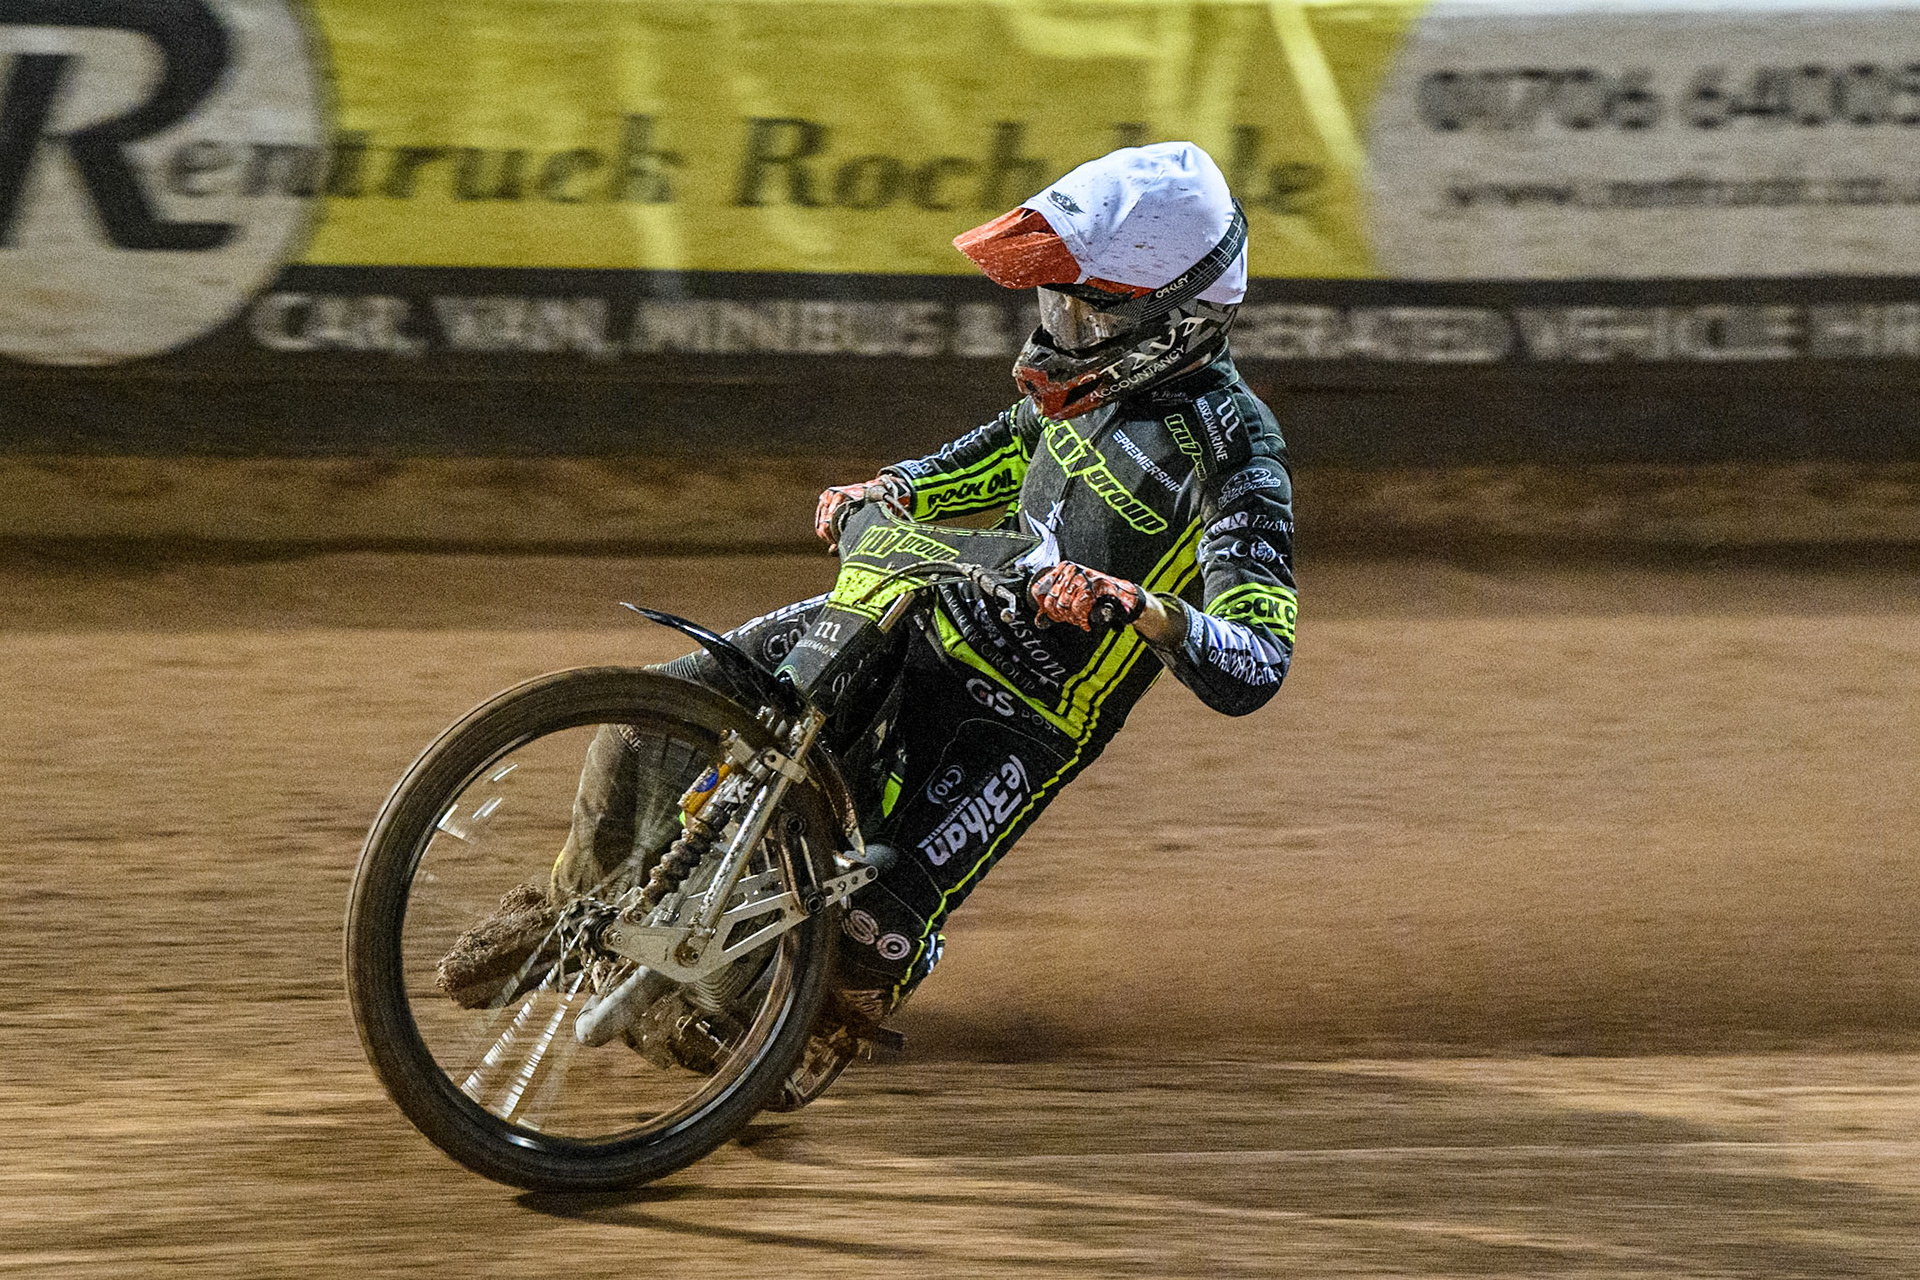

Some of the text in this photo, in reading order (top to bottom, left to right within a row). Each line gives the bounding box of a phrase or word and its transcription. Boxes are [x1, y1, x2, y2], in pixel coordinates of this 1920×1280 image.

[733, 117, 1326, 214] Rochle
[1155, 275, 1189, 299] OAKLEY
[1089, 343, 1186, 402] ACCOUNTANCY
[986, 467, 1019, 497] OIL
[1117, 433, 1183, 493] PREMIERSHIP
[1214, 596, 1282, 619] OCK
[1009, 610, 1067, 679] uston
